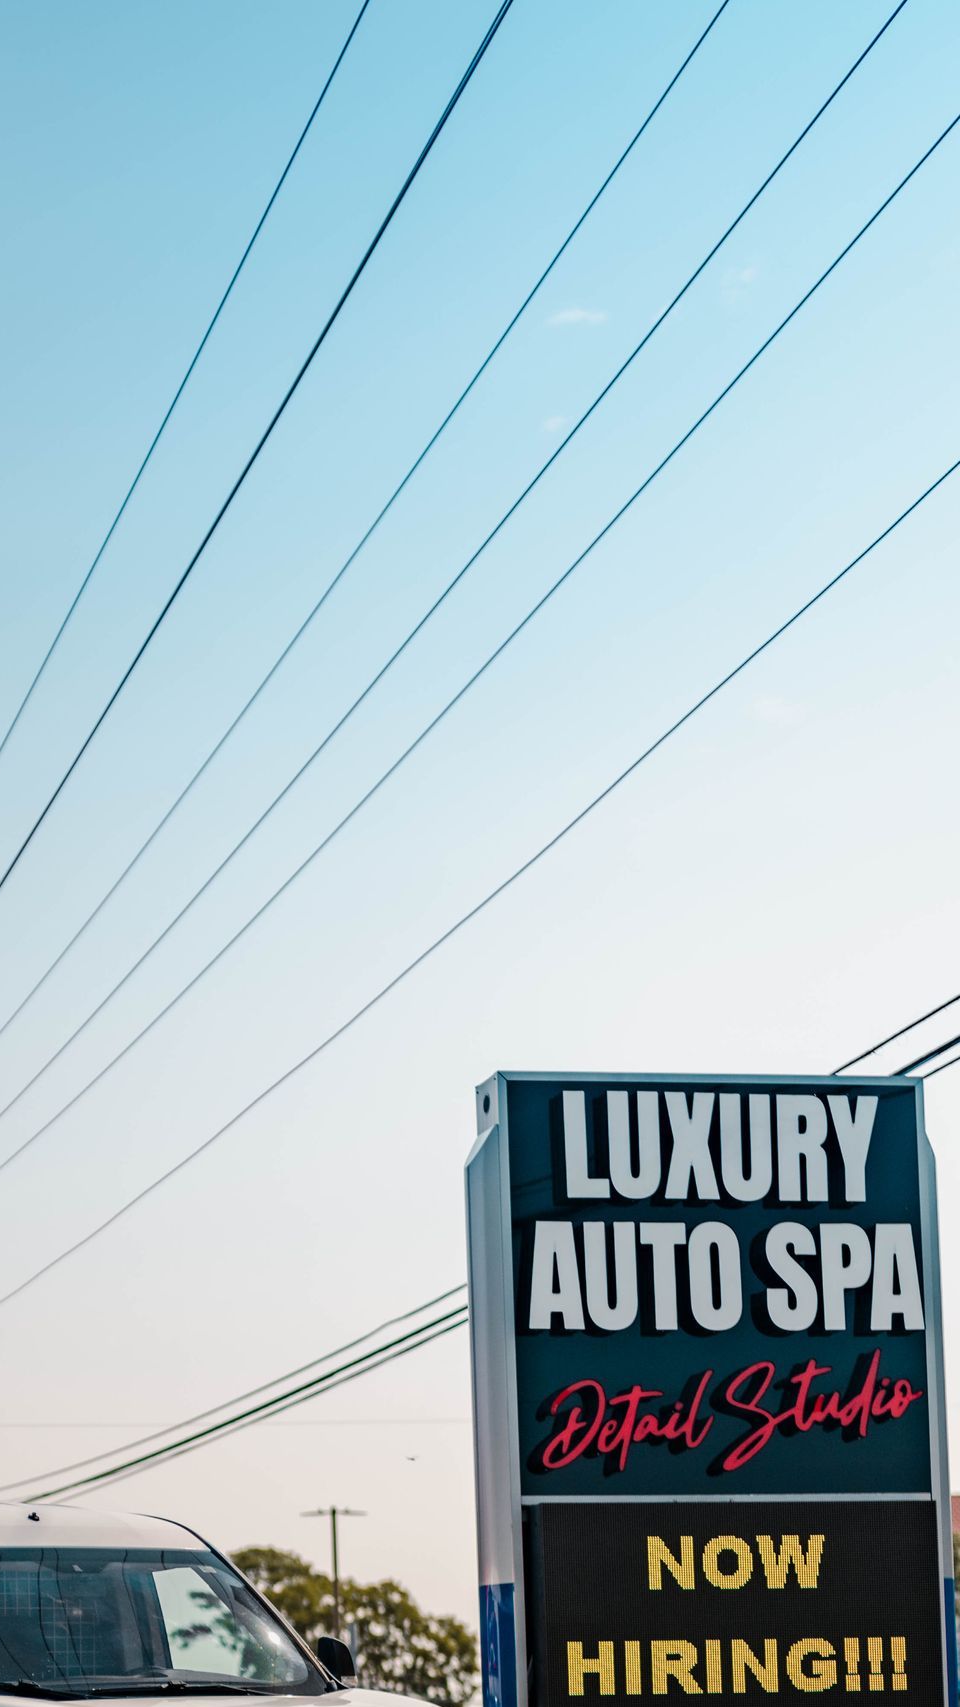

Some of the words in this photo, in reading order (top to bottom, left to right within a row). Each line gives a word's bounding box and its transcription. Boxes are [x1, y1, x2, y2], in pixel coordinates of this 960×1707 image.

[563, 1090, 878, 1202] LUXURY
[528, 1221, 742, 1331] AUTO
[765, 1221, 925, 1331] SPA
[541, 1370, 714, 1471] Detail
[723, 1349, 923, 1471] Studio
[647, 1534, 825, 1590] NOW
[567, 1636, 908, 1696] HIRING!!!
